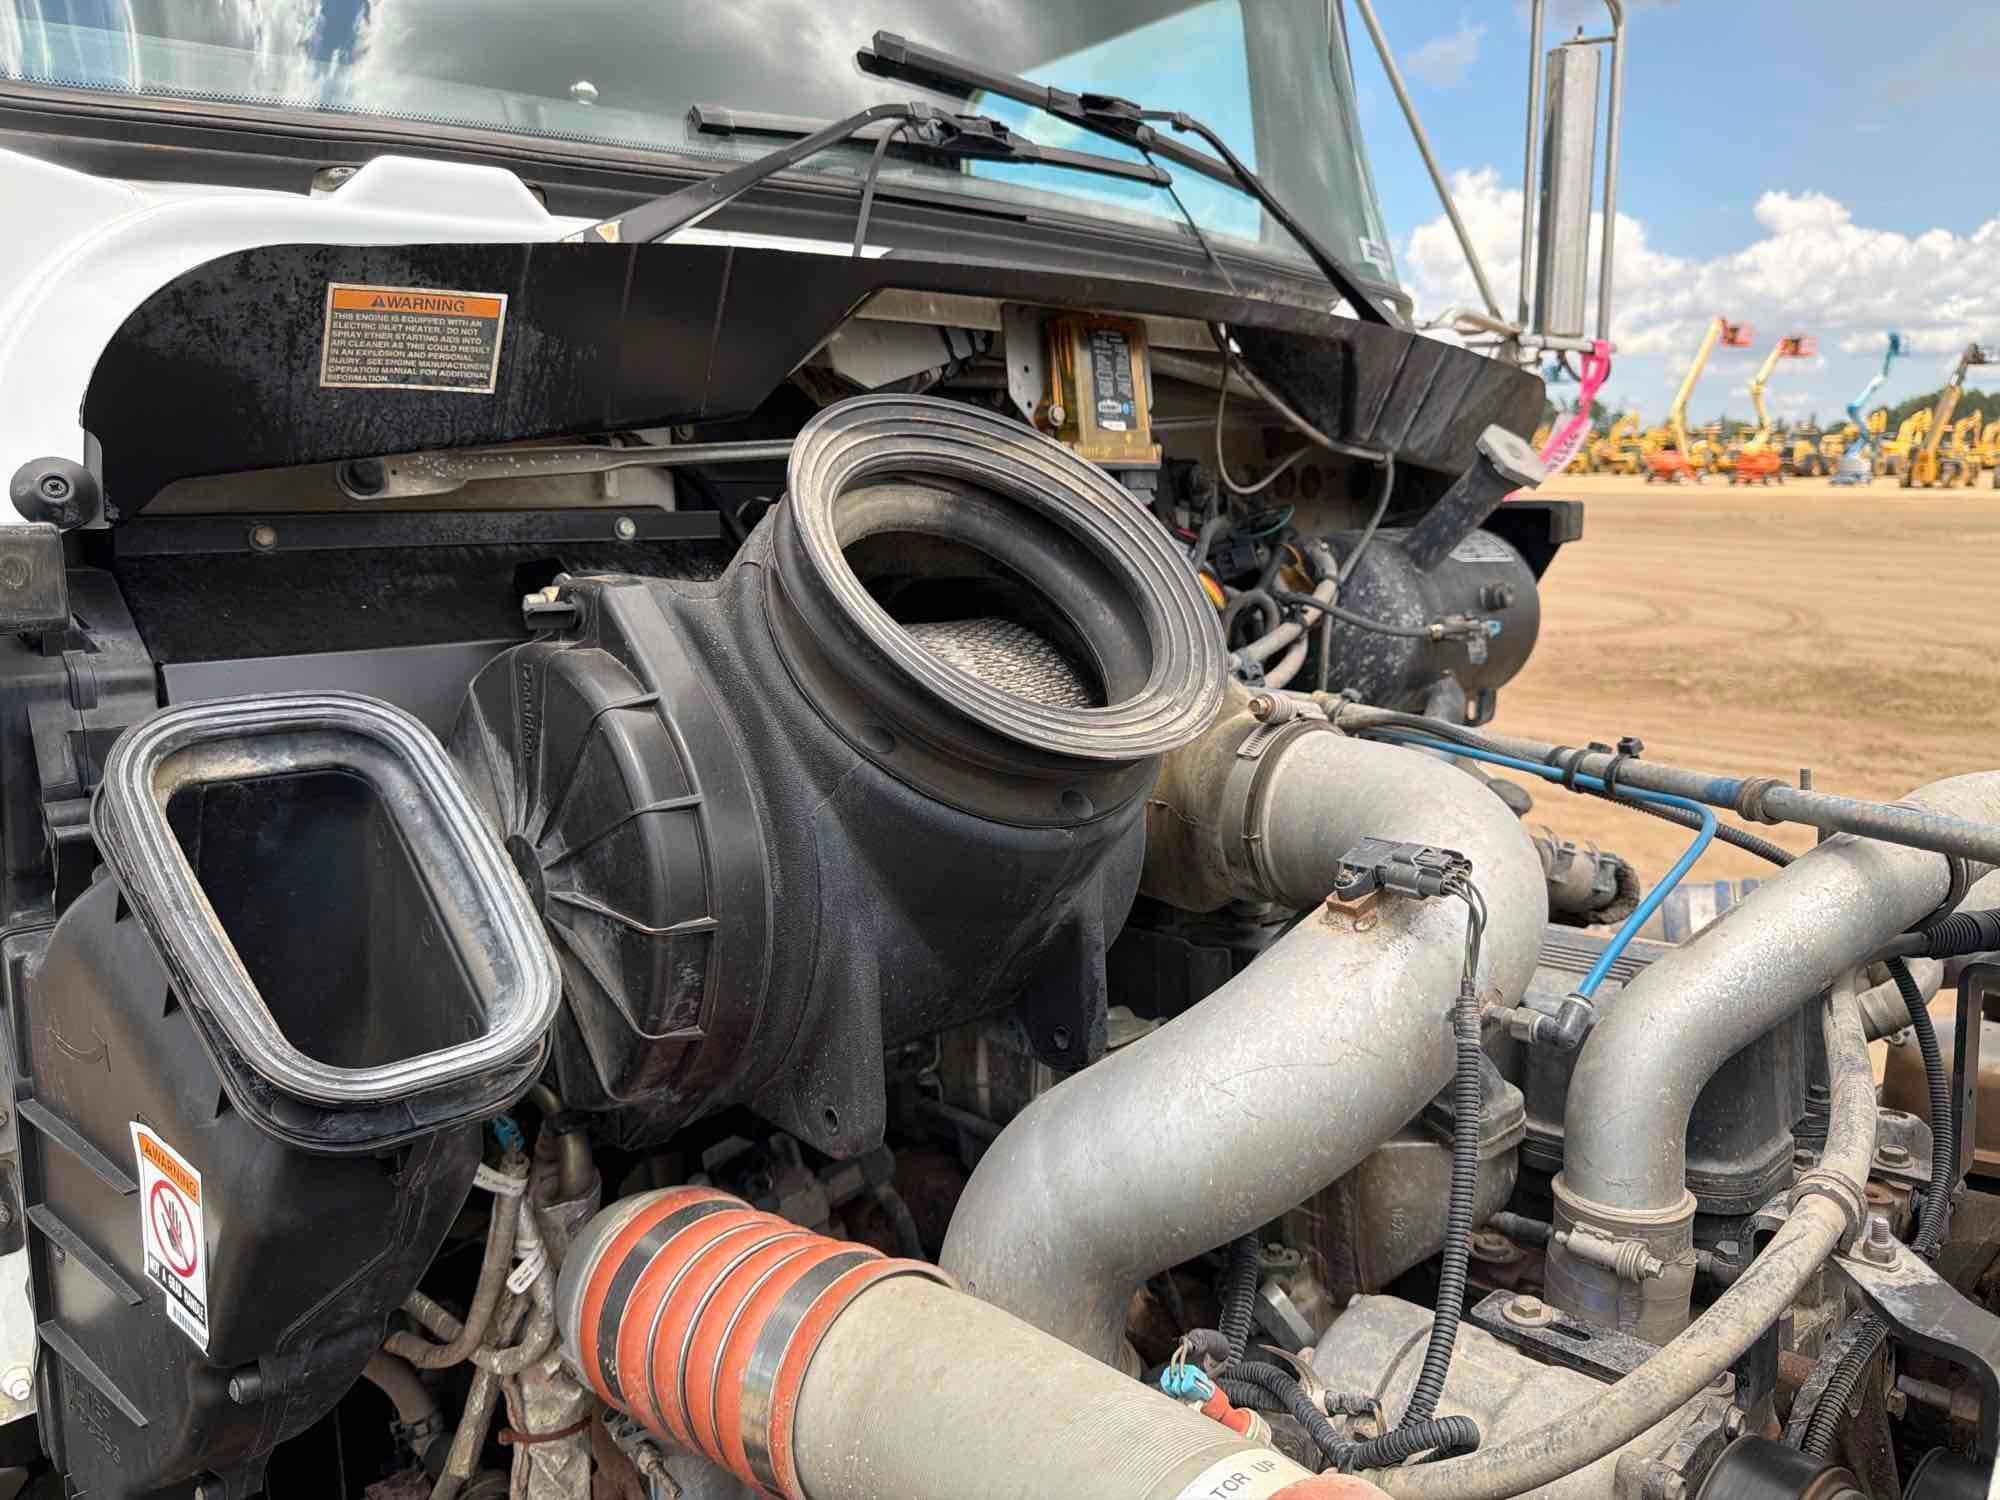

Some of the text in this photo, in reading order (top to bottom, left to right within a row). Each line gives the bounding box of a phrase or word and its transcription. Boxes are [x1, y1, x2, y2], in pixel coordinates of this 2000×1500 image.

[387, 295, 465, 312] WARNING
[334, 312, 353, 321] THIS
[356, 313, 390, 322] ENGINE
[448, 318, 469, 327] WITH
[333, 321, 376, 330] ELECTRIC
[447, 326, 459, 335] DO
[460, 327, 479, 336] NOT
[364, 332, 393, 341] ETHER
[395, 334, 439, 343] STARTING
[462, 337, 482, 345] INTO
[348, 340, 390, 349] CLEANER
[406, 342, 425, 351] THIS
[427, 343, 457, 353] COULD
[356, 349, 405, 358] EXPLOSION
[407, 351, 426, 360] AND
[328, 365, 489, 380] OPERATION MANUAL FOR ADDITIONAL
[328, 373, 390, 382] FORMATION.
[151, 1144, 197, 1199] WARNING
[1209, 1459, 1276, 1500] TOR UP
